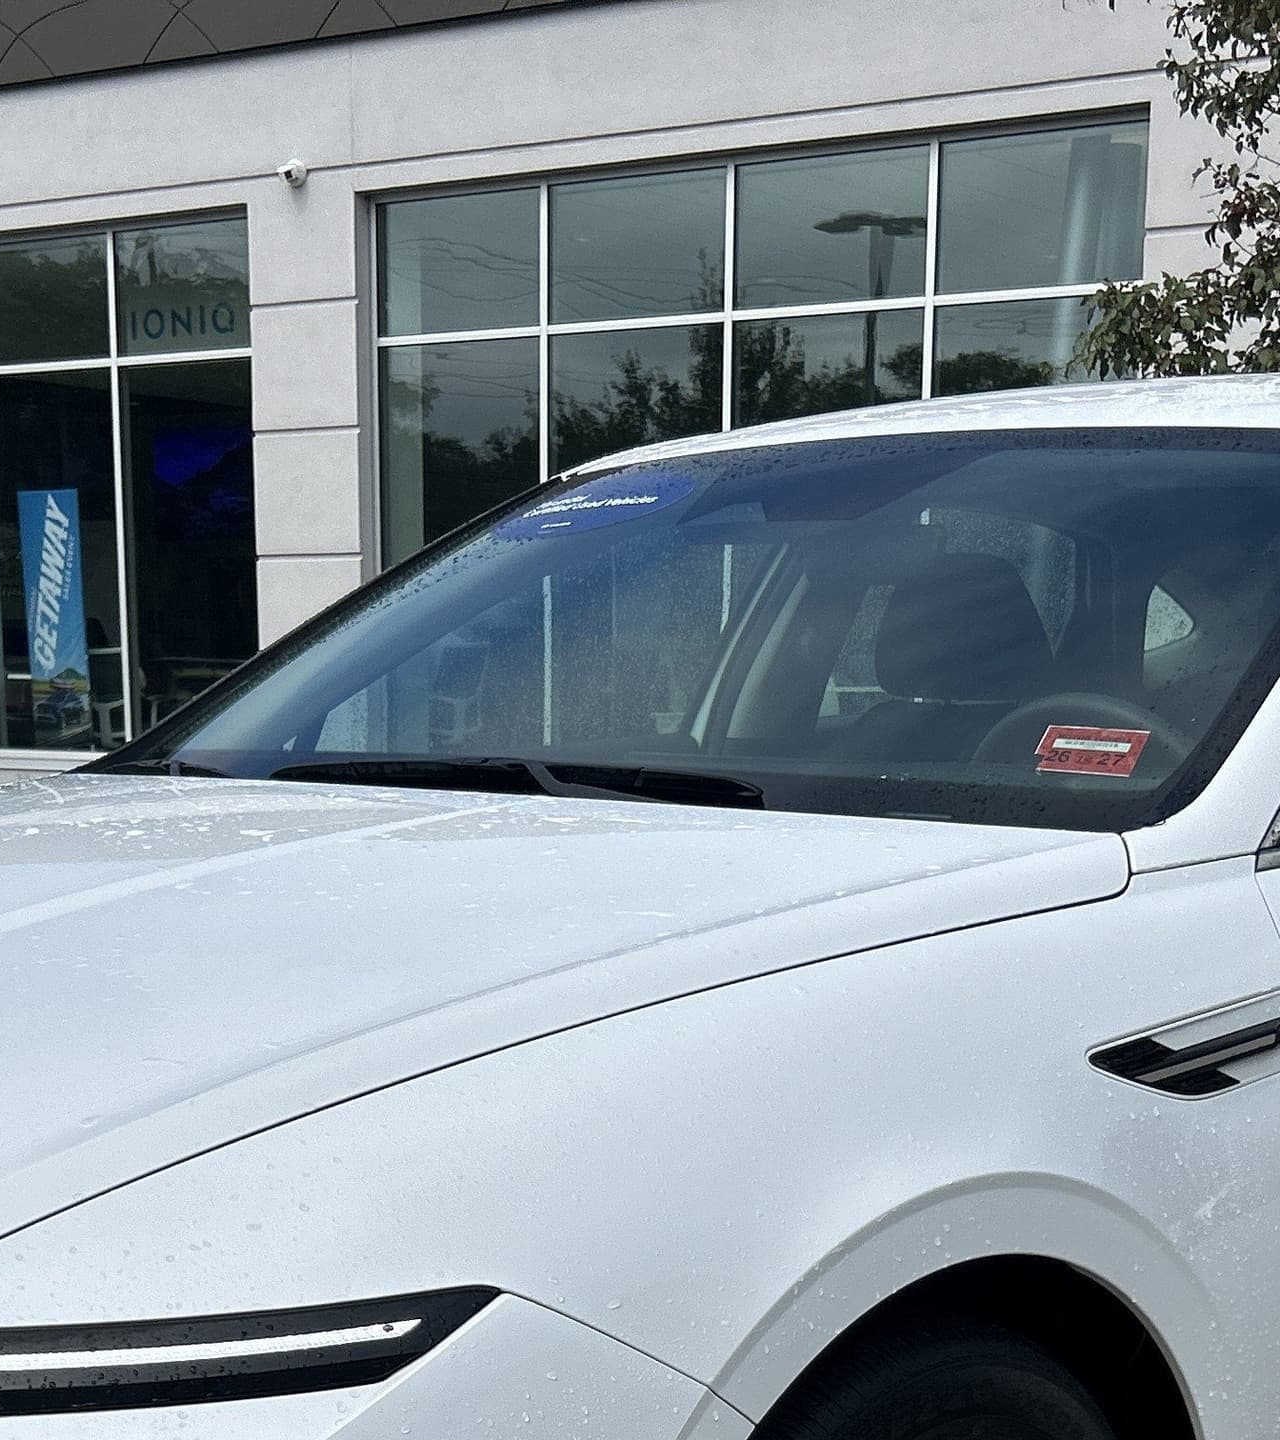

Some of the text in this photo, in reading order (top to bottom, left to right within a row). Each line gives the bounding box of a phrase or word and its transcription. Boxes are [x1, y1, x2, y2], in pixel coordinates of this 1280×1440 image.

[130, 302, 235, 341] IONIQ
[34, 493, 70, 673] GETAWAY
[1096, 752, 1127, 767] 27
